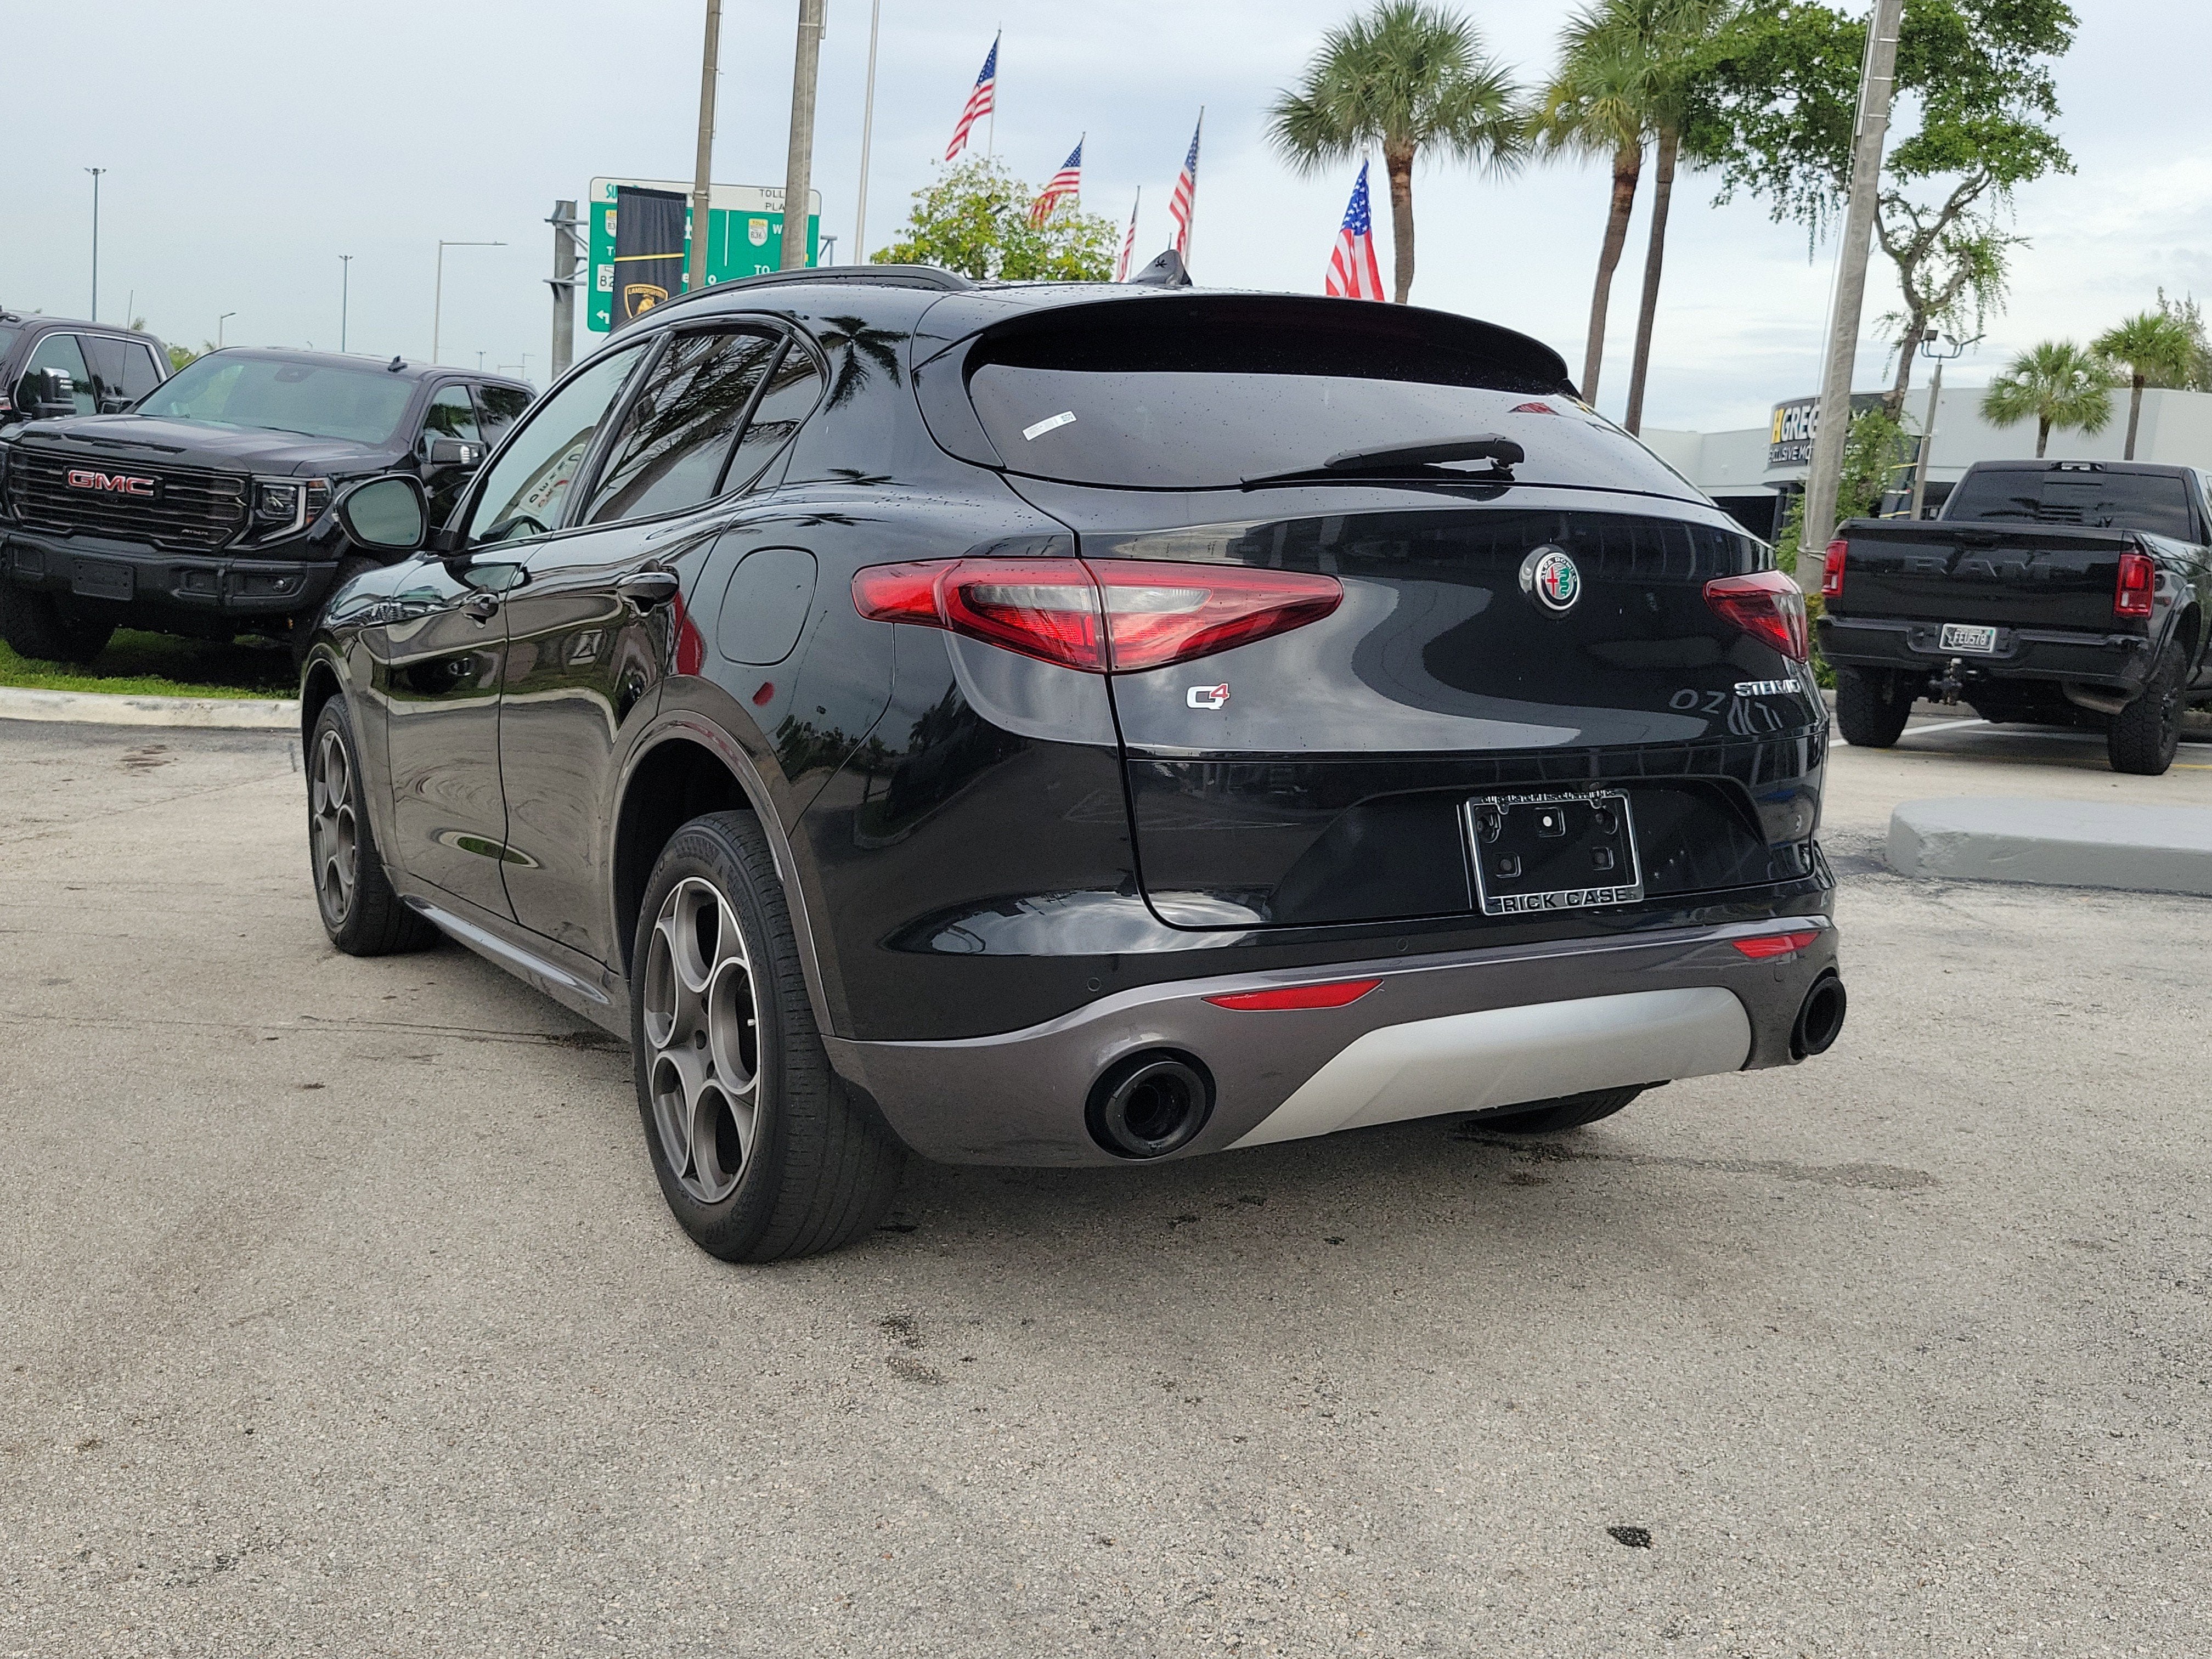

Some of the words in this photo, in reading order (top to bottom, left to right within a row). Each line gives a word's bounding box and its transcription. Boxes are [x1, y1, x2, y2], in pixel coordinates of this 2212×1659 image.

[759, 189, 785, 199] TOLL
[765, 202, 785, 211] PLA
[600, 275, 614, 287] 82
[69, 469, 155, 496] GMC
[1541, 560, 1553, 580] ALFA
[1555, 557, 1577, 582] ROMEO
[1905, 555, 2052, 579] RAM
[1186, 683, 1230, 710] Q4
[1734, 679, 1802, 697] STELVIO
[1502, 894, 1557, 913] RICK
[1565, 887, 1627, 907] CASE
